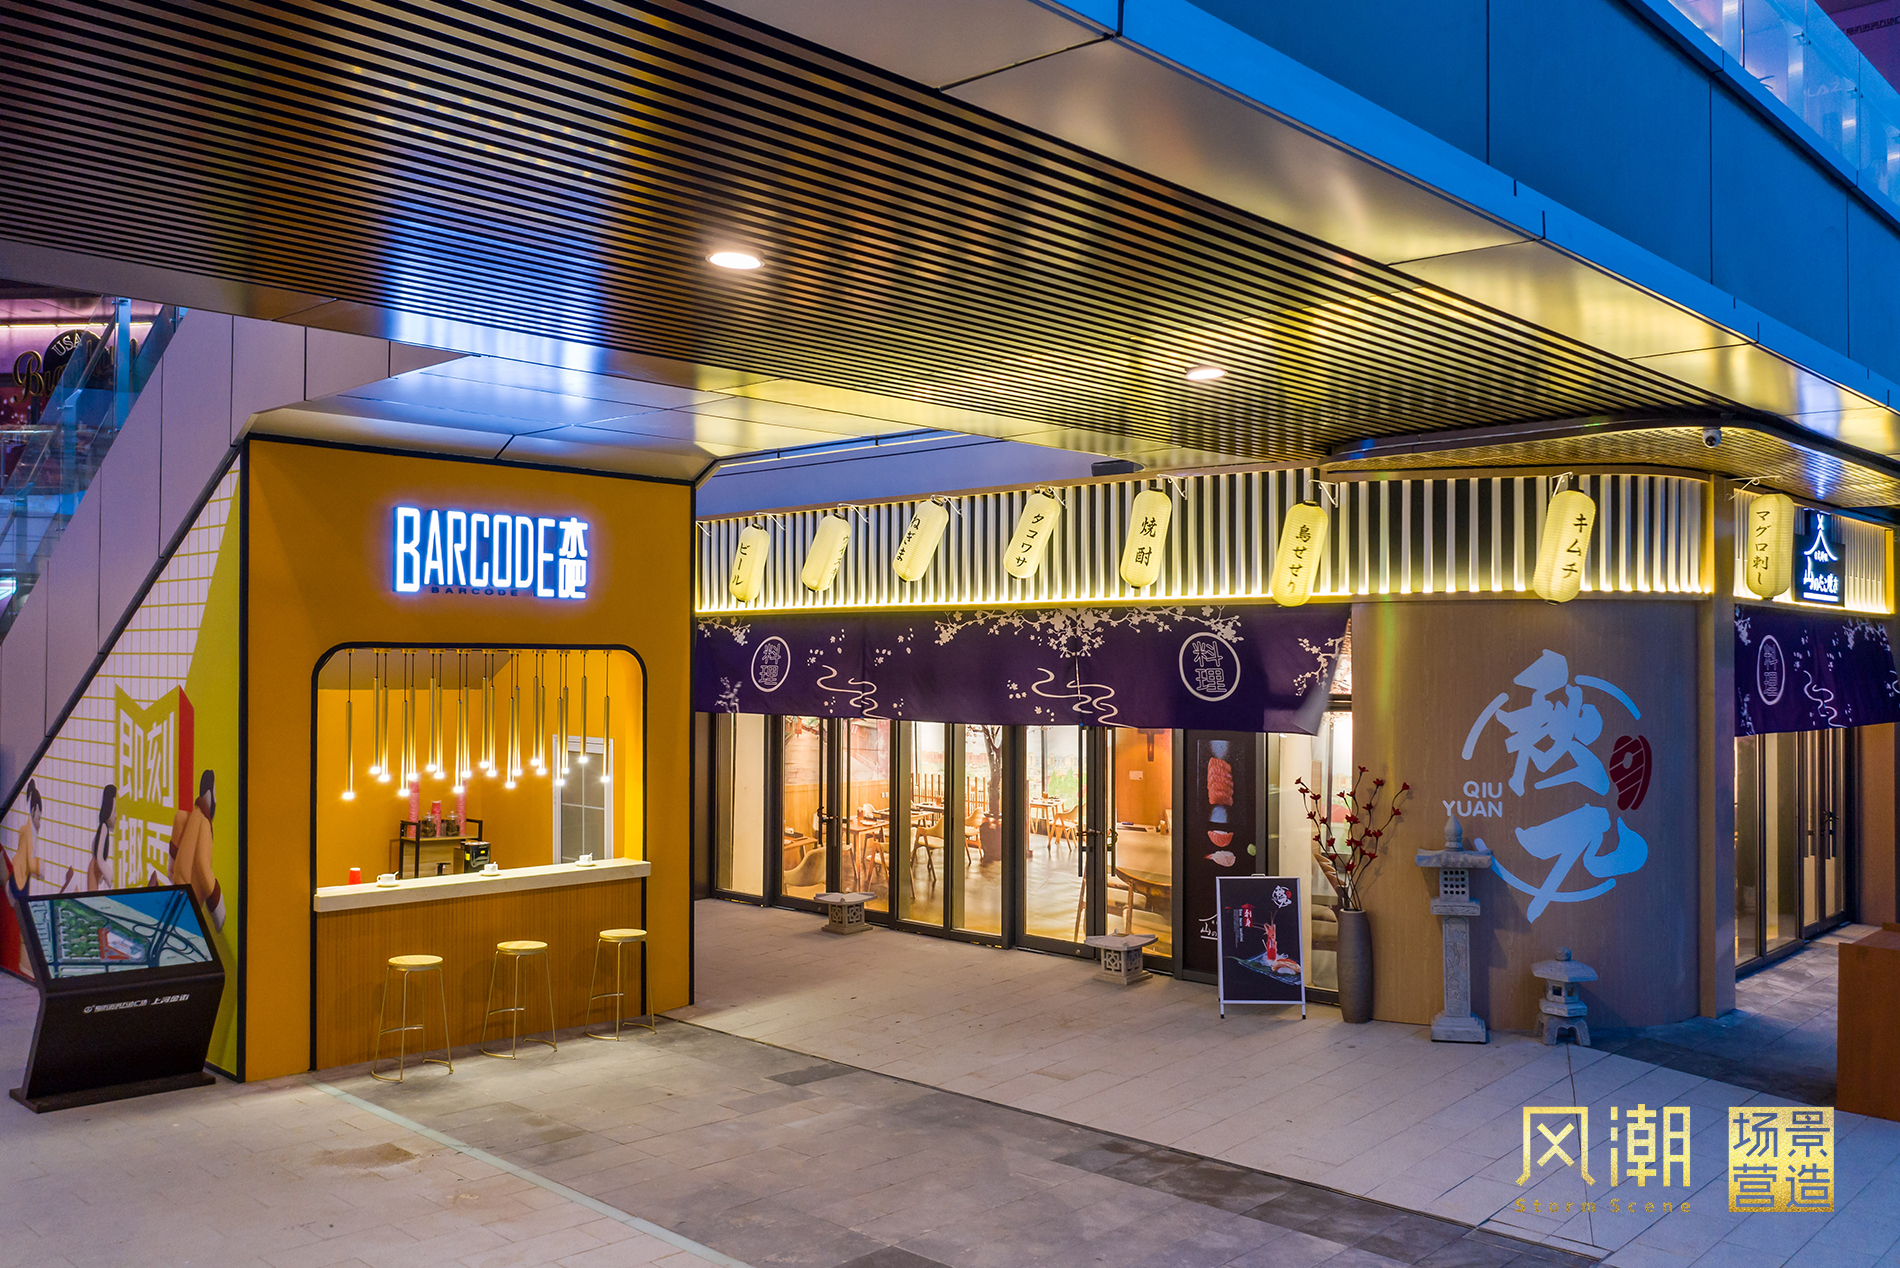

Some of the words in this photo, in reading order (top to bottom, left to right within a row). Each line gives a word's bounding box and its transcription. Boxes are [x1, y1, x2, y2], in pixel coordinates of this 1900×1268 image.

[51, 332, 83, 356] USA
[395, 506, 556, 598] BARCODE
[731, 542, 751, 586] ビール
[1015, 513, 1045, 568] タコワサ
[1134, 516, 1157, 567] 焼酎
[1562, 513, 1588, 579] キムチ
[1752, 509, 1770, 585] マグロ刺し
[431, 586, 519, 597] BARCODE
[758, 643, 782, 686] 料理
[1192, 640, 1228, 693] 料理
[118, 708, 175, 808] 即刻
[1442, 800, 1503, 818] YUAN
[1463, 780, 1503, 799] QIU
